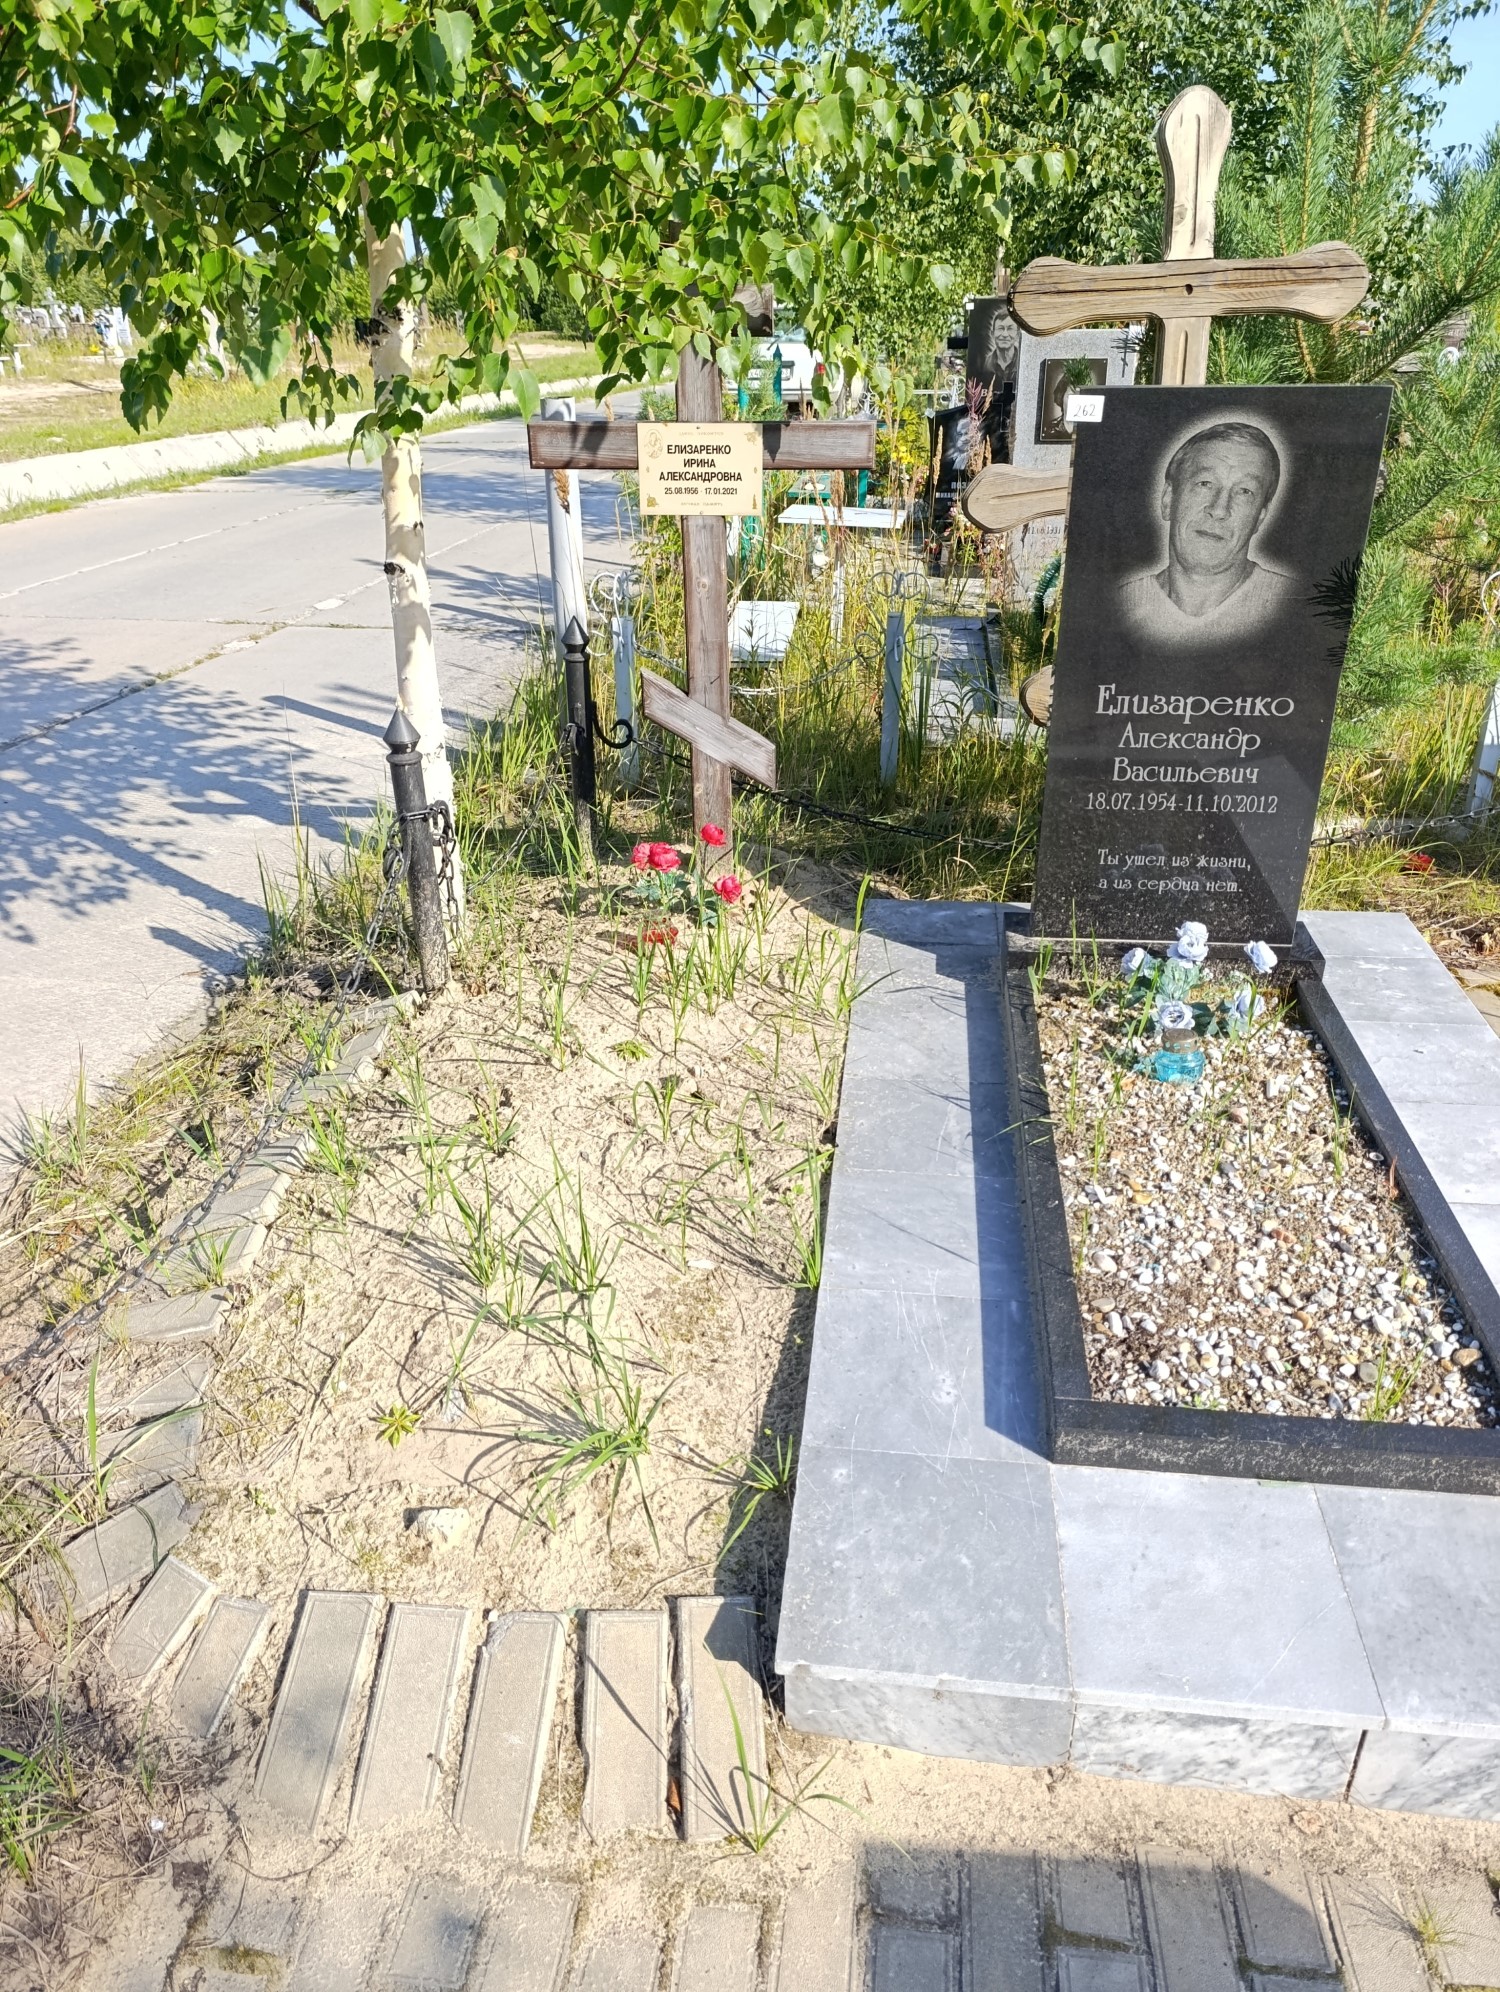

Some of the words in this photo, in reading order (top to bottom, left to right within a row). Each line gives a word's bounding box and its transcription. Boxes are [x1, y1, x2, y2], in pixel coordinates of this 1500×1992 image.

[1073, 403, 1096, 417] 262
[666, 444, 732, 455] ЕЛИЗАРЕНКО
[683, 458, 716, 468] ИРИНА
[659, 471, 742, 483] АЛЕКСАНДРОВНА
[664, 487, 699, 495] 25.08.1956
[704, 487, 738, 495] 17.01.2021
[1095, 683, 1295, 725] Елизаренко
[1118, 721, 1261, 758] Александр
[1112, 757, 1260, 784] Васильевич
[1097, 849, 1119, 865] Ты
[1122, 854, 1166, 870] ушел
[1171, 856, 1190, 867] из
[1196, 854, 1251, 871] жизни,
[1098, 878, 1108, 889] а
[1113, 878, 1132, 889] из
[1137, 876, 1200, 894] сердца
[1206, 880, 1243, 892] нет.
